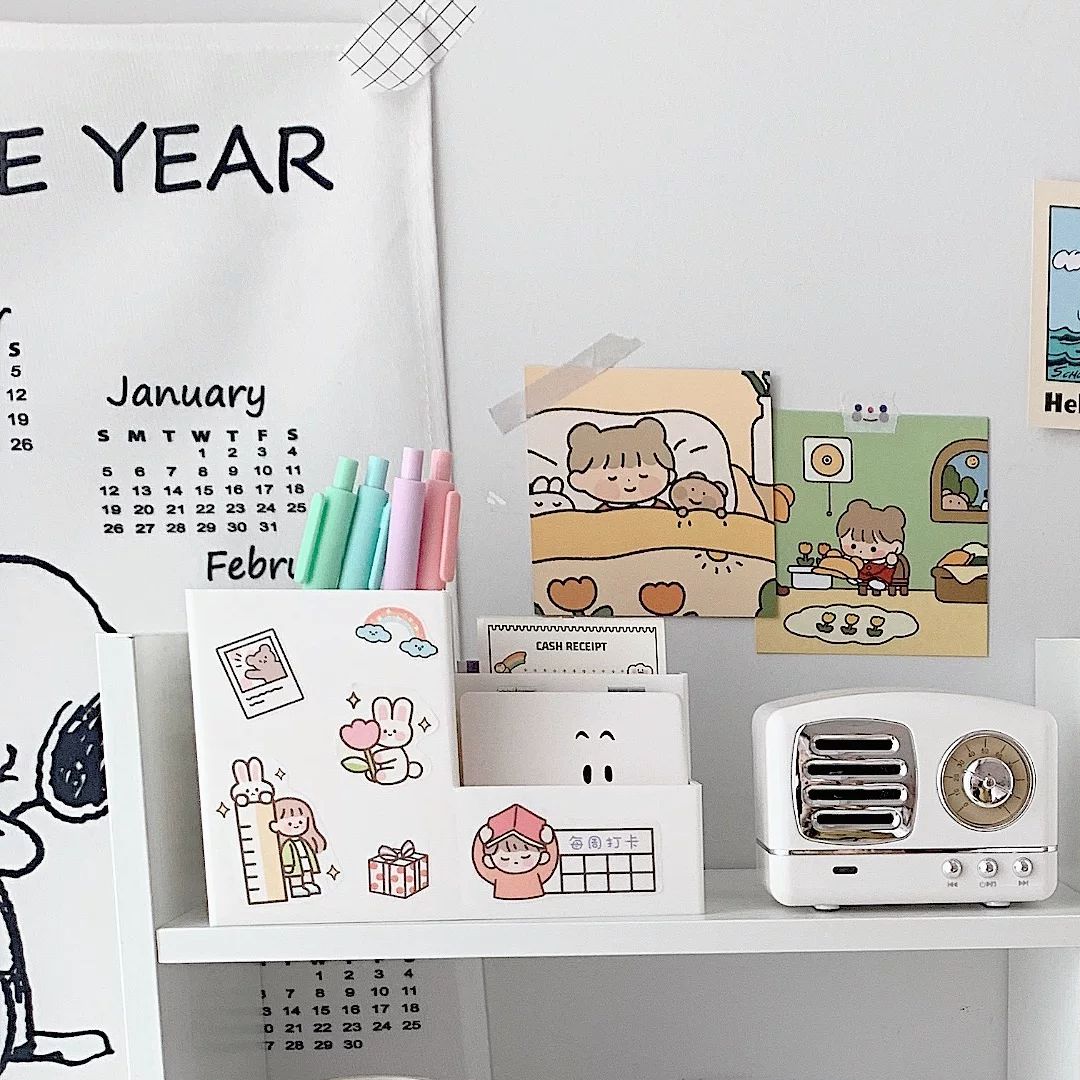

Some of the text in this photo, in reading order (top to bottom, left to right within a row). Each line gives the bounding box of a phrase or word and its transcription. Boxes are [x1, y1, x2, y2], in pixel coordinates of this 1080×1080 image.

[81, 121, 335, 195] YEAR
[8, 341, 21, 358] S
[10, 364, 22, 378] 5
[5, 388, 28, 402] 12
[106, 375, 266, 418] January
[7, 412, 30, 427] 19
[96, 427, 299, 443] S M T W T F S
[10, 437, 34, 452] 26
[198, 445, 298, 459] 1 2 3 4
[102, 464, 301, 478] 5 6 7 8 9 10 11
[99, 483, 305, 497] 12 13 14 15 16 17 18
[101, 502, 307, 516] 19 20 21 22 23 24 25
[103, 521, 278, 535] 26 27 28 29 30 31
[536, 641, 608, 652] CASH RECEIPT
[569, 834, 640, 850] 每周打卡
[315, 967, 414, 981] 1 2 3 4
[285, 985, 417, 999] 7 8 9 10 11
[282, 1002, 421, 1016] 14 15 16 17 18
[284, 1020, 422, 1034] 21 22 23 24 25
[284, 1039, 364, 1051] 28 29 30
